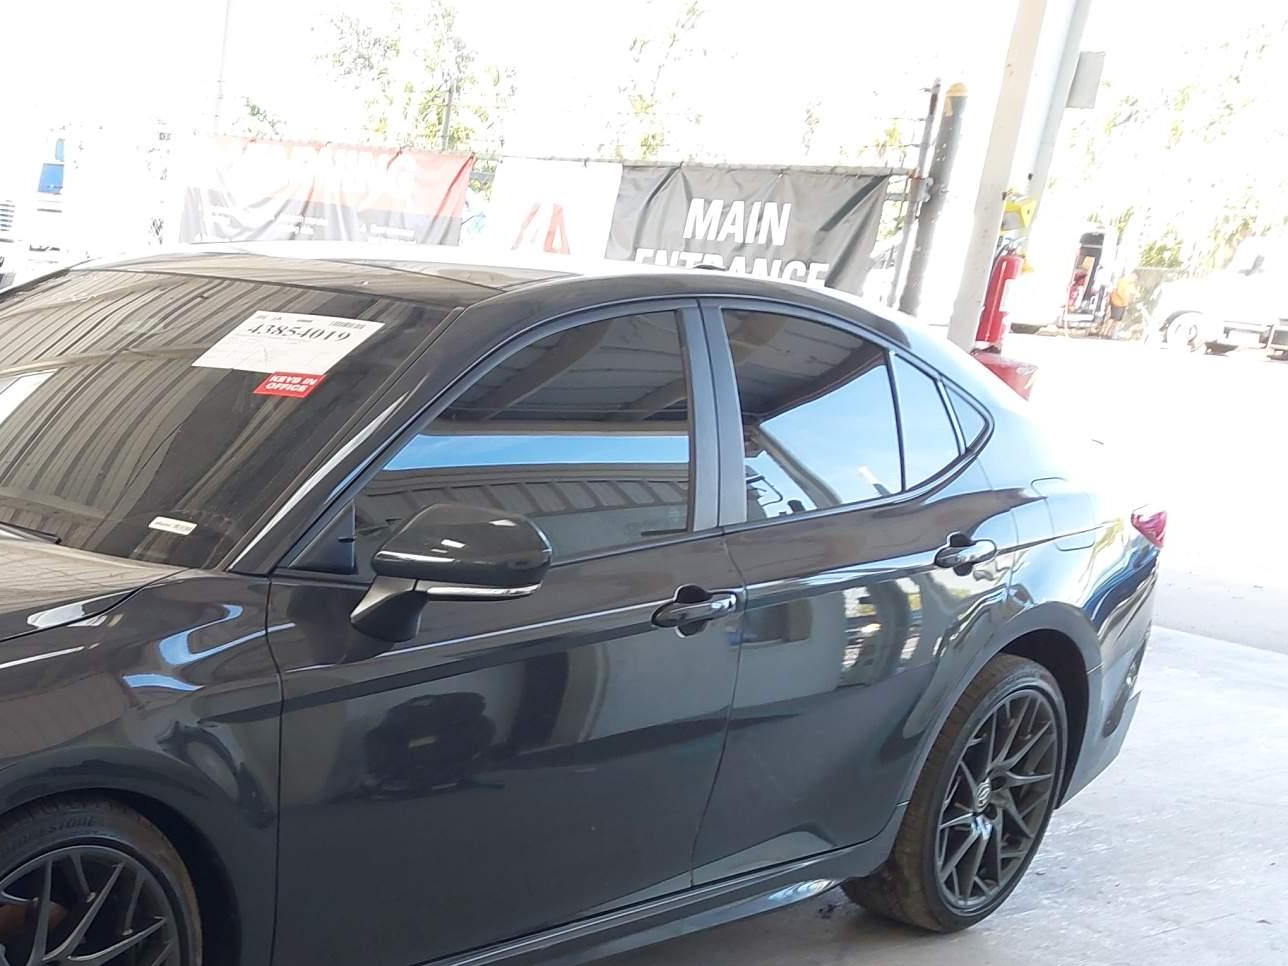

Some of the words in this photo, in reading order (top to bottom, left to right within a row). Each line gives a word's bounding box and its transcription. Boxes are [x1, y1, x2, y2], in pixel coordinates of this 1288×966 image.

[683, 198, 791, 246] MAIN
[247, 323, 351, 342] 43854019
[265, 382, 309, 393] OFFICE
[302, 378, 318, 386] IN
